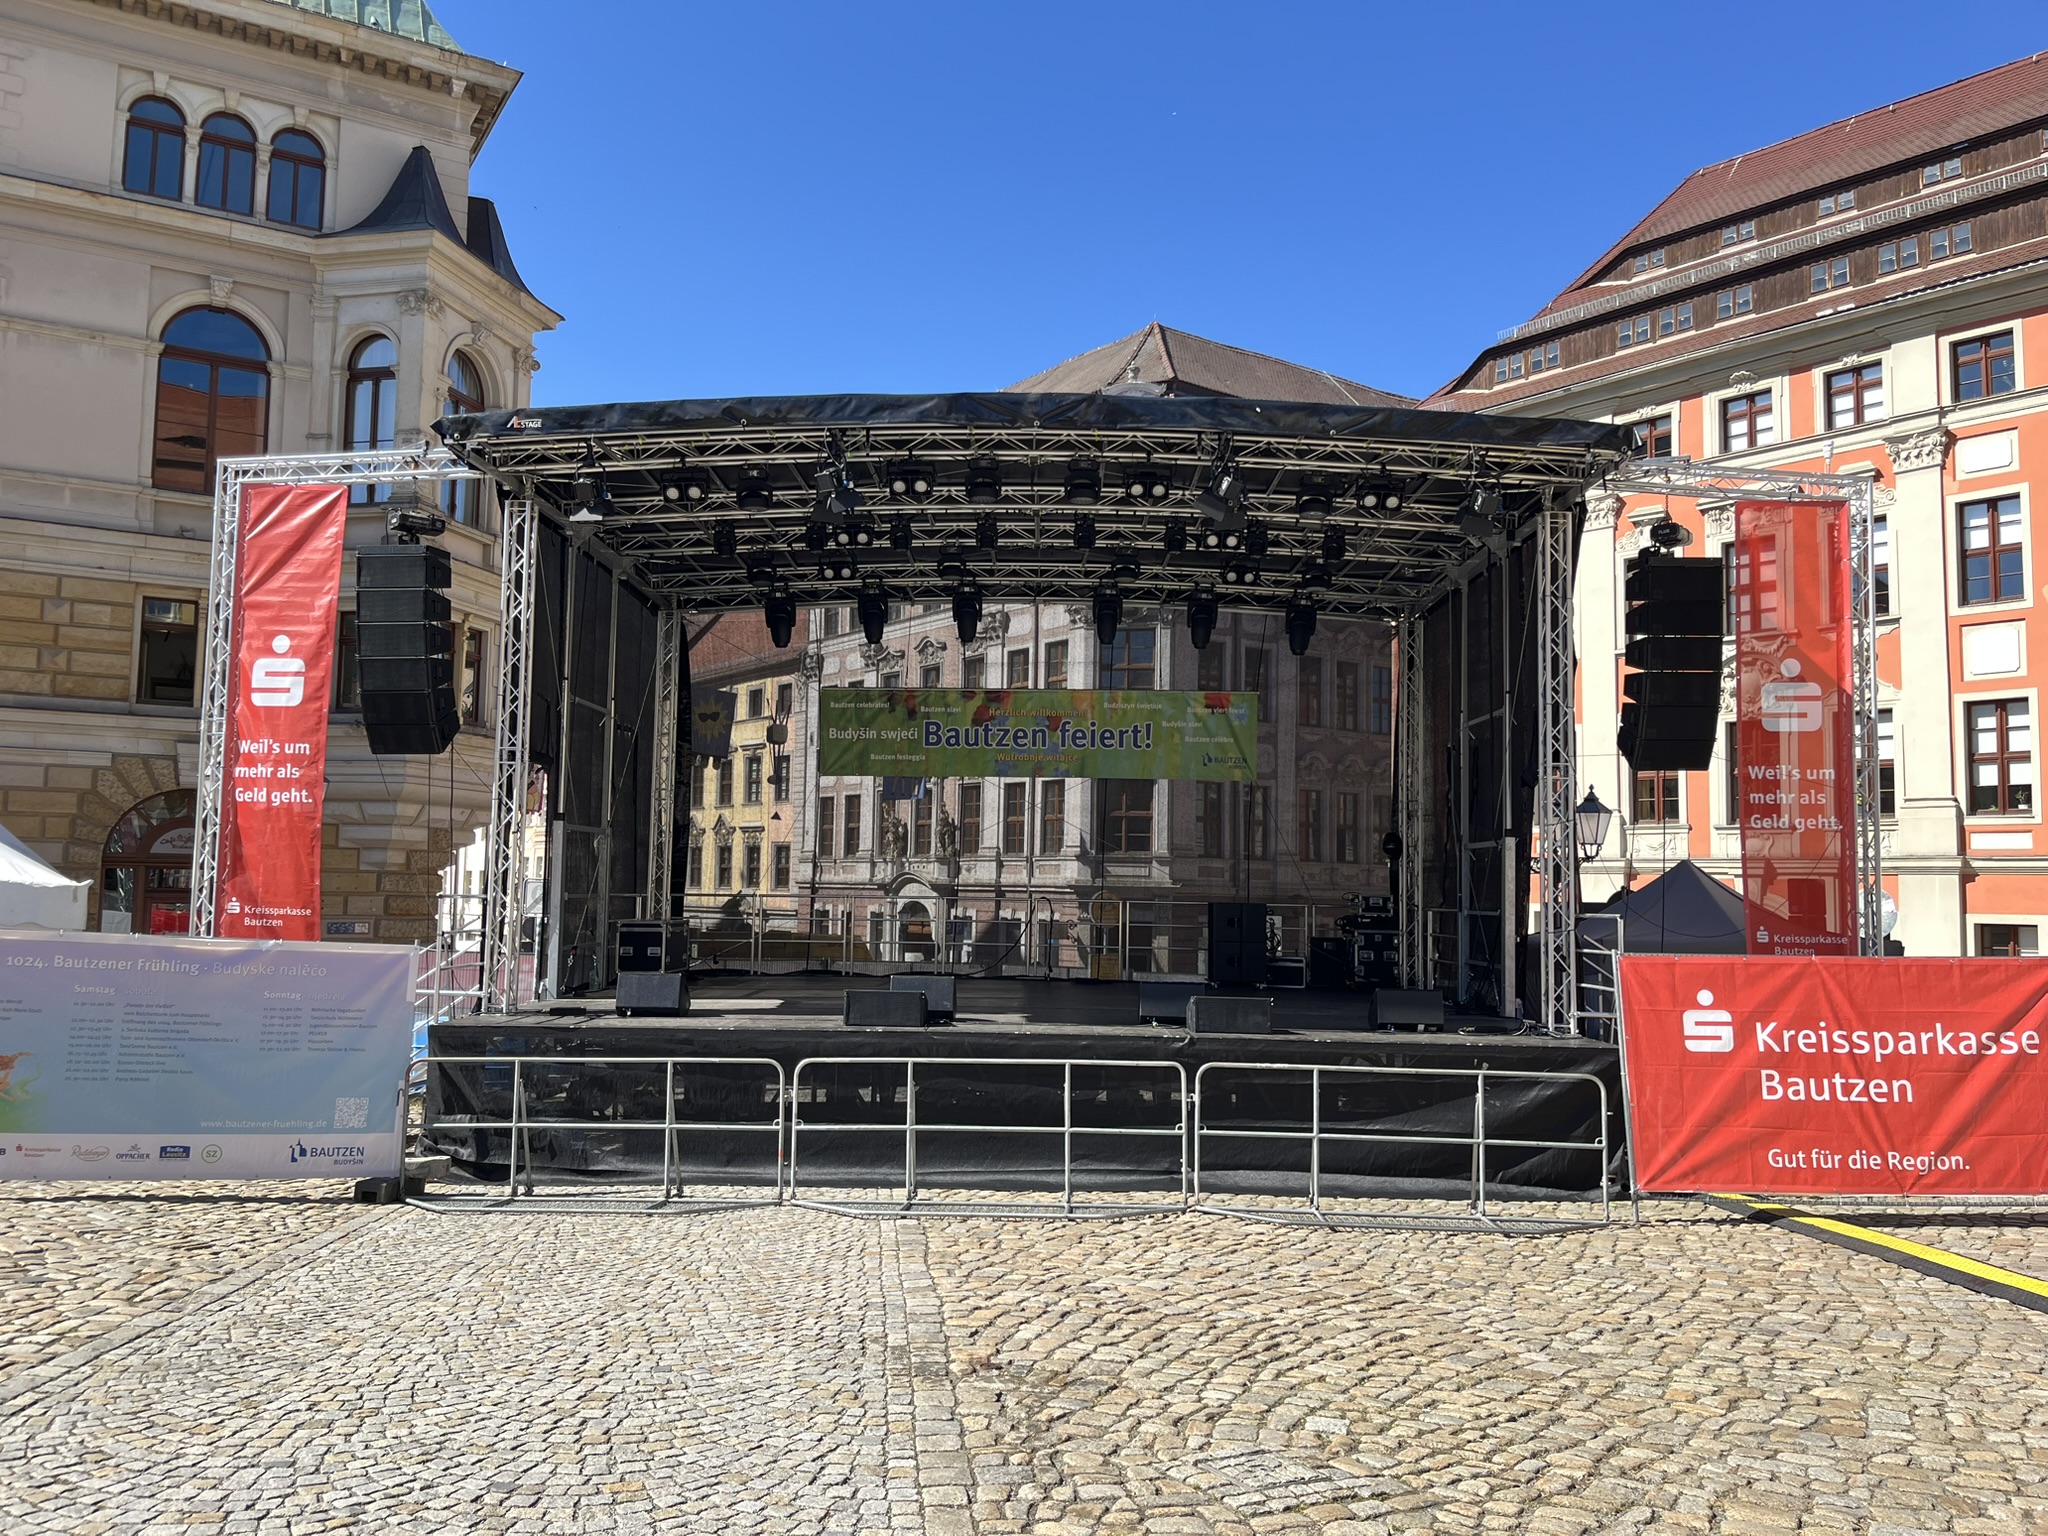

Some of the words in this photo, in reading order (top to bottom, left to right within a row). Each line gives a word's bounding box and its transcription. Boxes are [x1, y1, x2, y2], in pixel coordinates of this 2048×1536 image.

[988, 708, 1026, 716] Herzlich
[829, 728, 876, 741] Budyšin
[880, 728, 918, 742] swjeći
[924, 720, 1049, 750] Bautzen
[1058, 720, 1153, 750] feiert!
[284, 742, 310, 755] um
[236, 764, 274, 778] mehr
[277, 764, 299, 778] als
[1806, 768, 1836, 780] um
[235, 788, 266, 802] Geld
[271, 788, 312, 806] geht.
[1750, 790, 1794, 804] mehr
[1800, 790, 1826, 804] als
[1750, 814, 1789, 829] Geld
[1795, 814, 1844, 832] geht.
[244, 906, 312, 918] Kreissparkasse
[244, 918, 283, 927] Bautzen
[1774, 934, 1848, 945] Kreissparkasse
[1774, 946, 1814, 956] Bautzen
[6, 956, 48, 969] 1024.
[54, 955, 133, 970] Bautzener
[138, 958, 200, 976] Frühling
[213, 962, 275, 976] Budyske
[74, 984, 116, 996] Samstag
[264, 990, 302, 1000] Sonntag
[1755, 1022, 2040, 1062] Kreissparkasse
[1760, 1070, 1914, 1102] Bautzen
[200, 1120, 327, 1130] www.bautzener-fruehling.de
[310, 1147, 364, 1158] BAUTZEN
[1768, 1148, 1807, 1168] Gut
[1810, 1148, 1842, 1169] für
[1848, 1150, 1882, 1170] die
[1888, 1152, 1970, 1176] Region.
